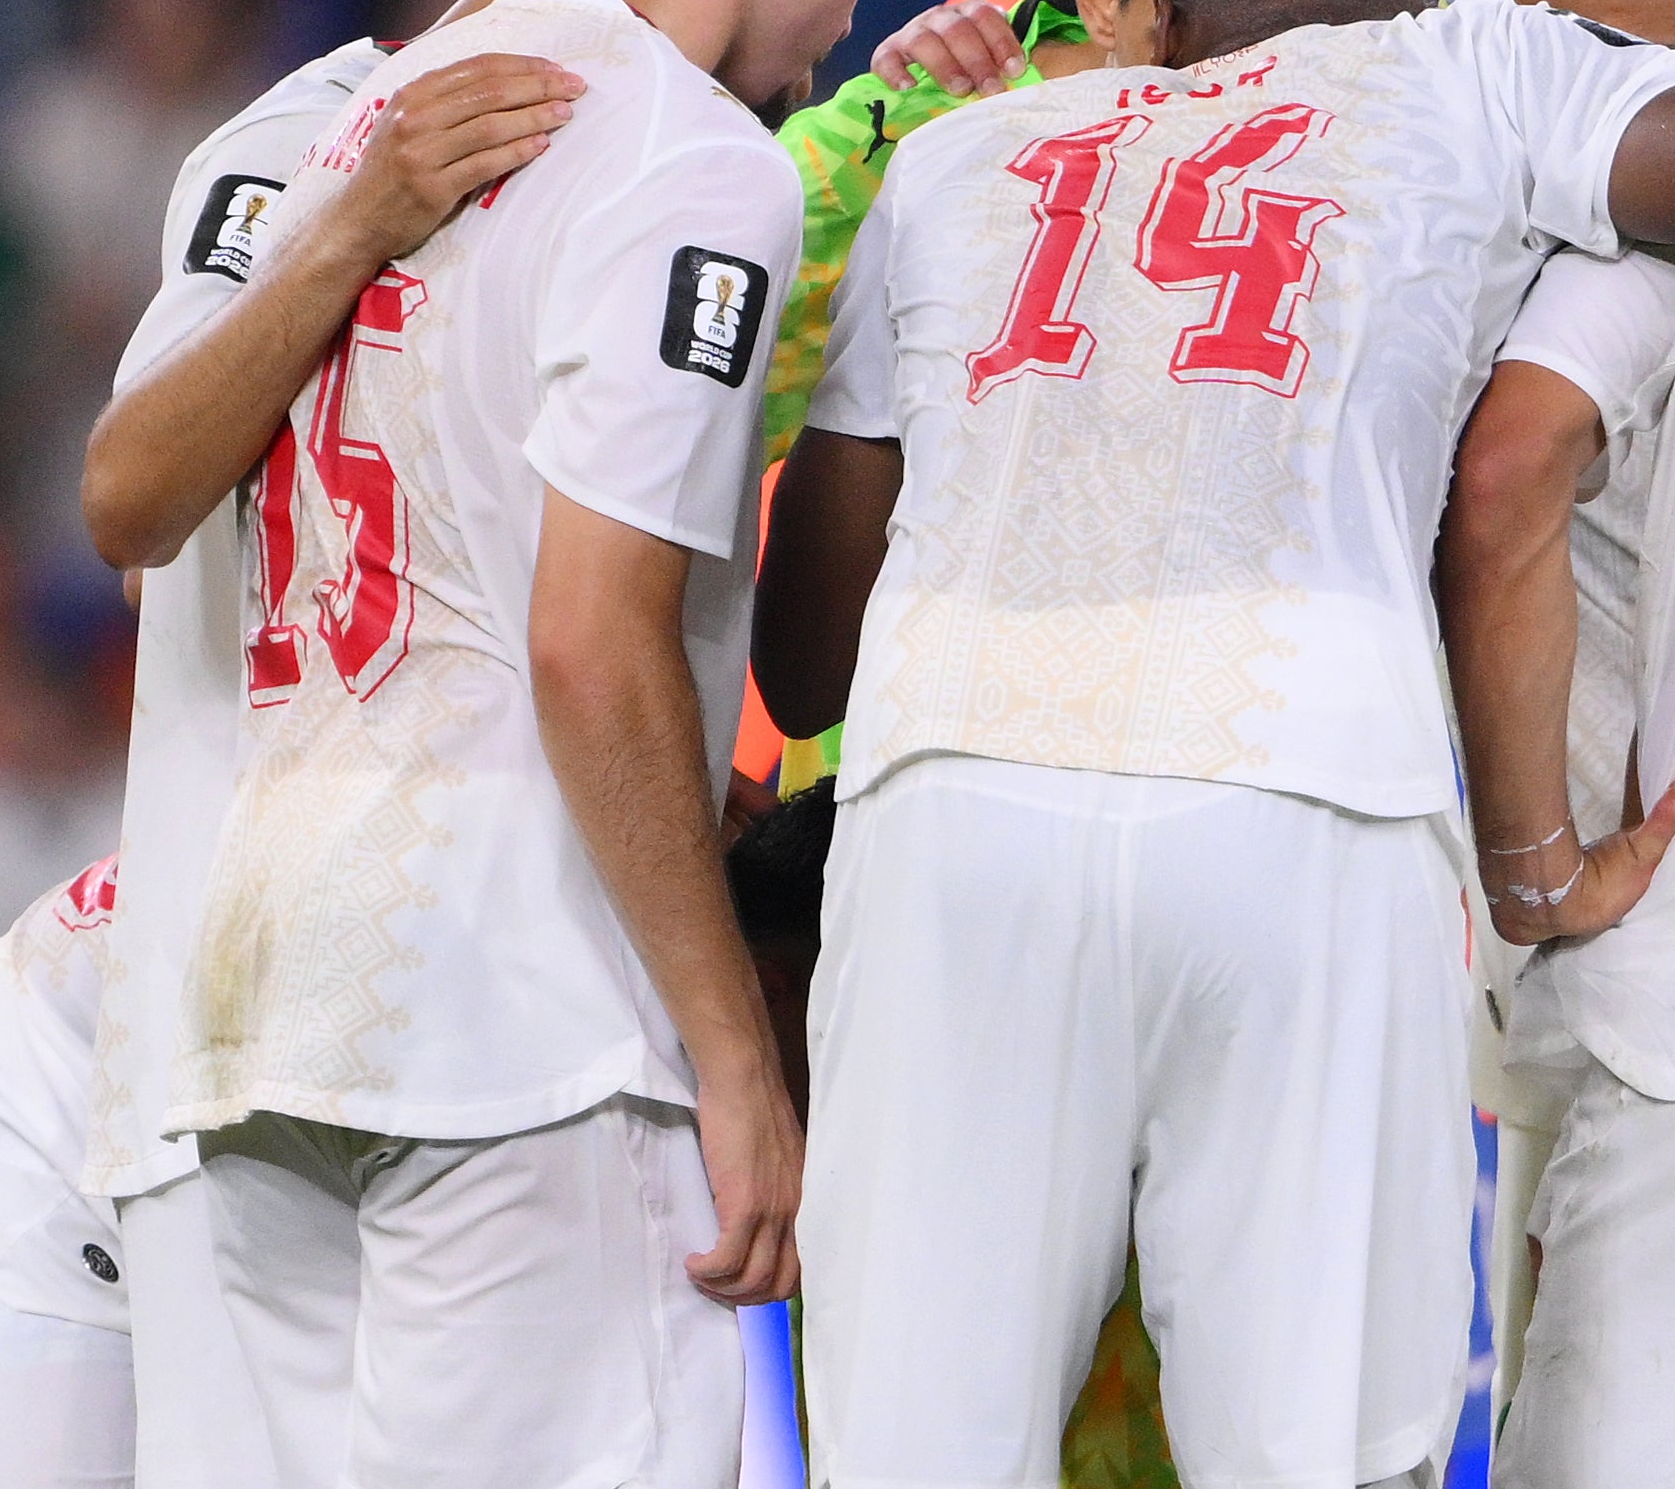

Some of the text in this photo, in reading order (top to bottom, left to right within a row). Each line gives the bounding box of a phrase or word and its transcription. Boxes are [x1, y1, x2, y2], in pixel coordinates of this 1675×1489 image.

[688, 349, 731, 374] 2026
[966, 104, 1347, 405] 14
[247, 263, 426, 709] 15
